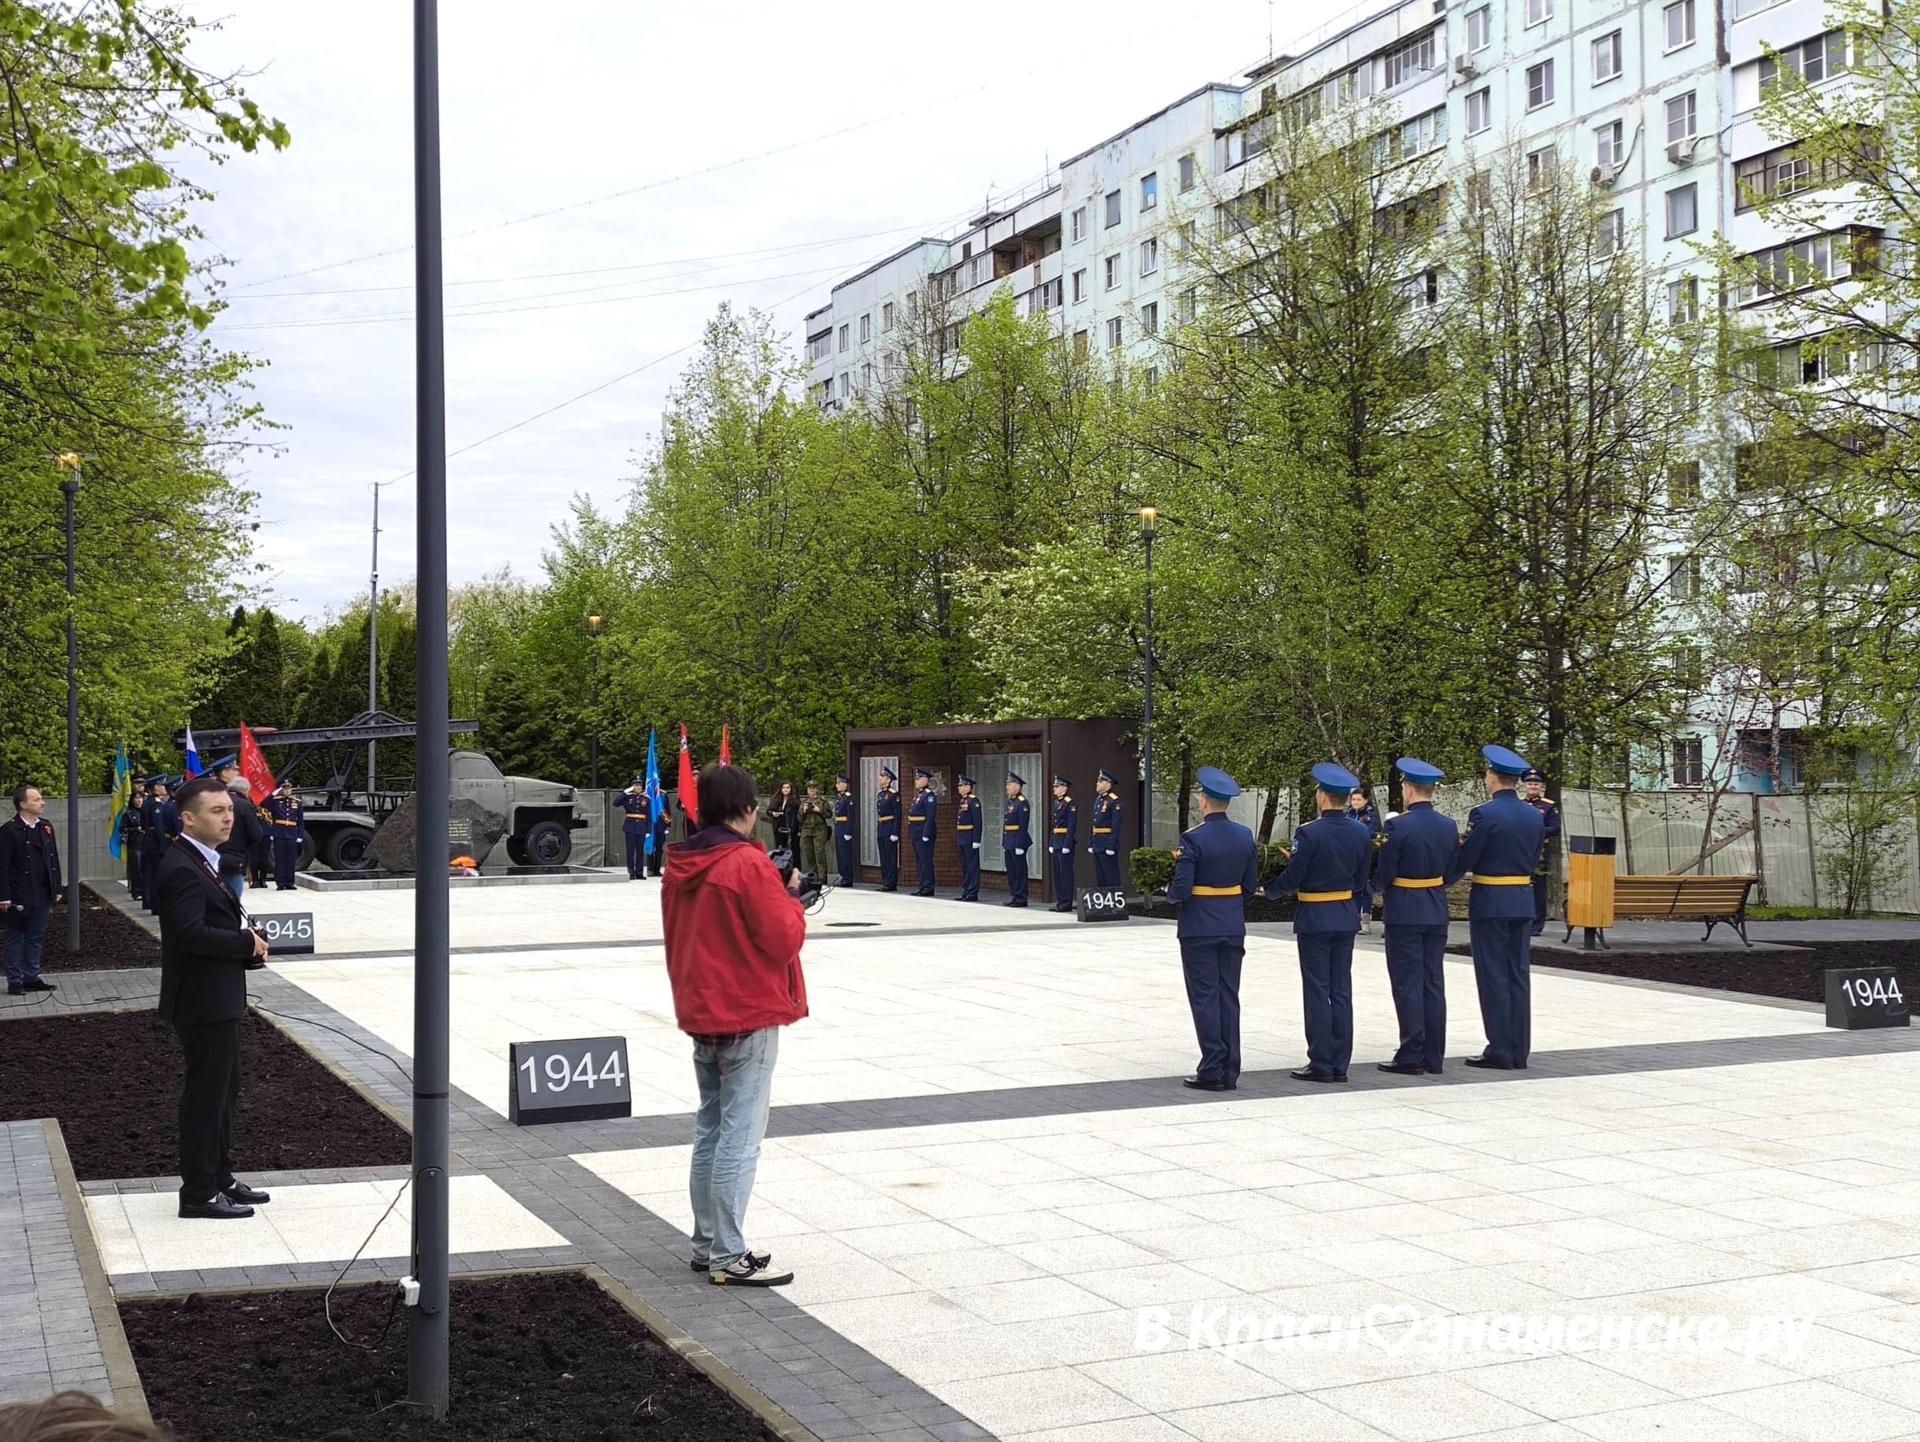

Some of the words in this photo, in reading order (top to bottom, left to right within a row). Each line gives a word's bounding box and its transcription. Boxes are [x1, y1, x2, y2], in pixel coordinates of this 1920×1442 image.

[1083, 891, 1126, 910] 1945
[1842, 976, 1903, 1007] 1944
[520, 1050, 625, 1094] 1944
